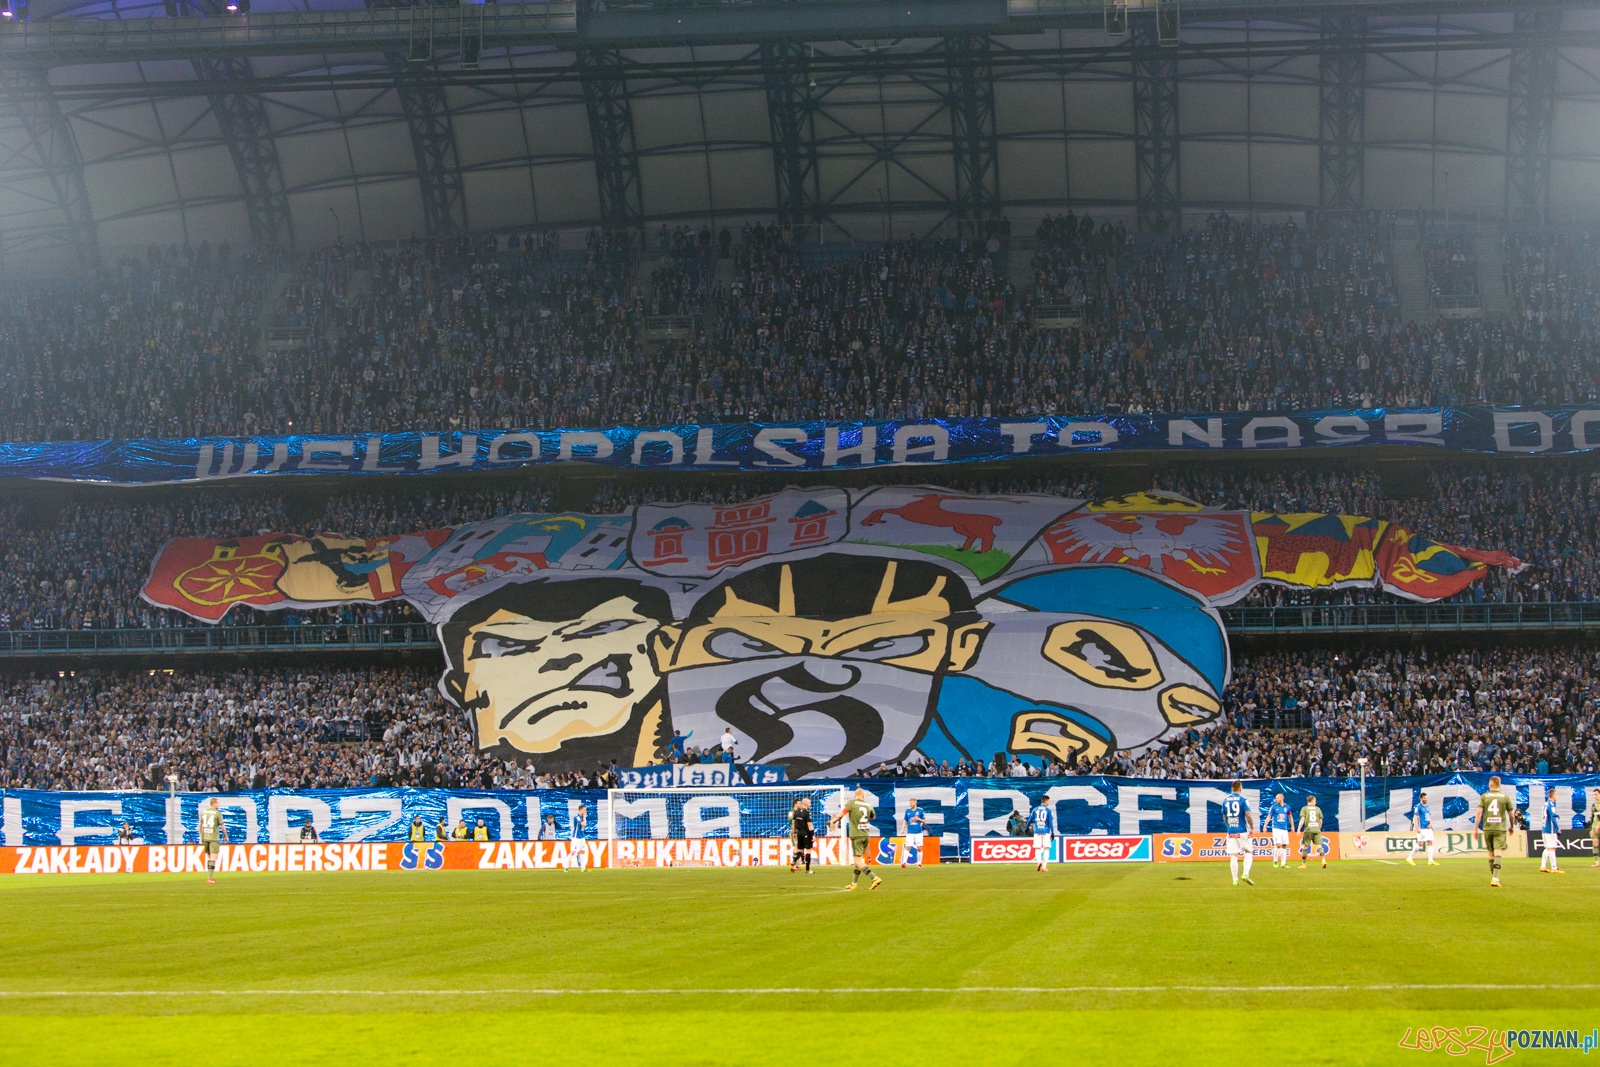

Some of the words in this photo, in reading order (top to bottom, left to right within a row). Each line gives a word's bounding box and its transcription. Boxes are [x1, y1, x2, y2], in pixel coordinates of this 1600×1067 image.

[999, 421, 1120, 453] TO
[858, 806, 870, 823] 2
[1035, 809, 1048, 822] 10
[1224, 801, 1241, 817] 19
[1308, 810, 1318, 822] 8
[1487, 798, 1500, 816] 4
[202, 813, 216, 828] 14
[400, 842, 444, 870] STS
[977, 841, 1031, 859] tesa
[1070, 838, 1125, 858] tesa
[1161, 837, 1193, 858] STS
[15, 845, 141, 873] ZAKŁADY
